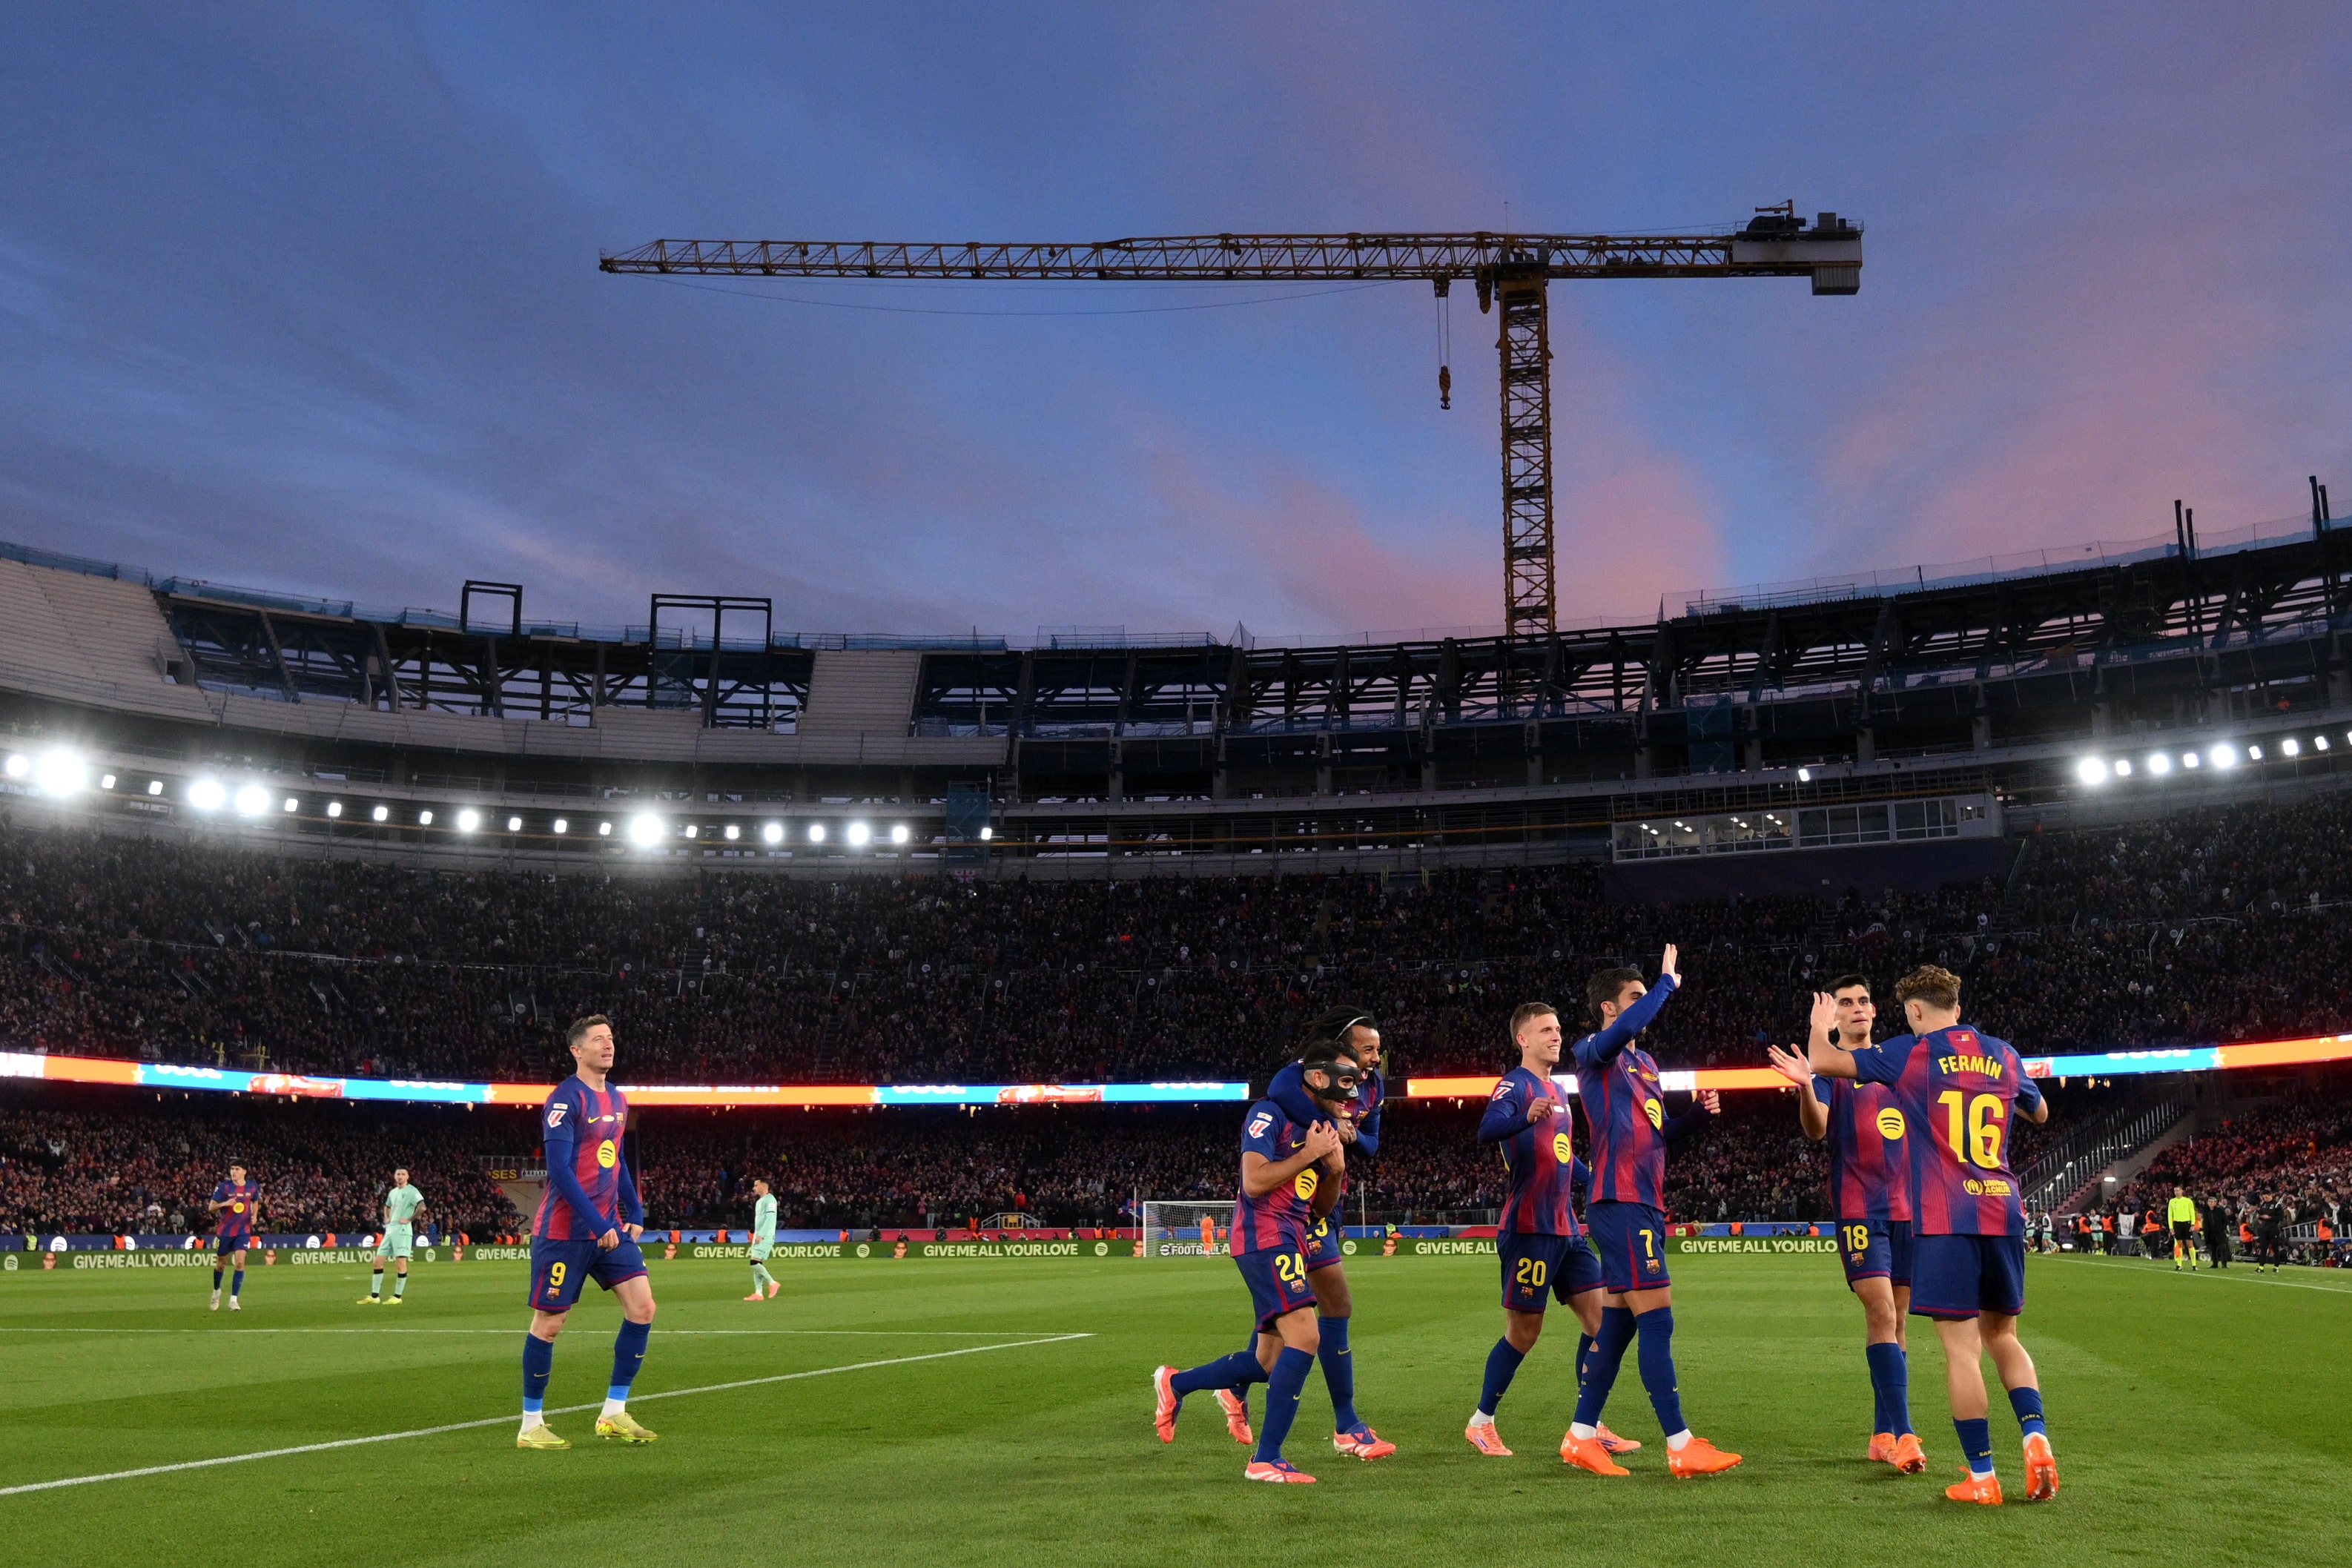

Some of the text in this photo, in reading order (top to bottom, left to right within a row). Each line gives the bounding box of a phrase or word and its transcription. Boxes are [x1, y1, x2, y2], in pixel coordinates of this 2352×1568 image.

[1938, 1055, 2002, 1079] FERMÍN
[1937, 1090, 2004, 1168] 16
[486, 1169, 517, 1180] SES
[1639, 1229, 1654, 1258] 7
[1843, 1225, 1869, 1251] 18
[475, 1248, 532, 1260] GIVE ME AL
[693, 1246, 724, 1258] GIVE
[724, 1246, 745, 1258] ME
[771, 1246, 806, 1258] YOUR
[807, 1246, 841, 1257] LOVE
[924, 1243, 1079, 1257] GIVE ME ALL YOUR LOVE
[1416, 1242, 1450, 1254] GIVE
[1451, 1242, 1474, 1254] ME
[1680, 1240, 1838, 1253] GIVE ME ALL YOUR LO
[73, 1253, 217, 1269] GIVE ME ALL YOUR LOVE
[291, 1251, 319, 1265] GIVE
[320, 1251, 336, 1264] ME
[337, 1251, 357, 1264] ALL
[357, 1250, 376, 1263] YO
[550, 1262, 566, 1286] 9
[1275, 1253, 1306, 1281] 24
[1516, 1257, 1547, 1286] 20
